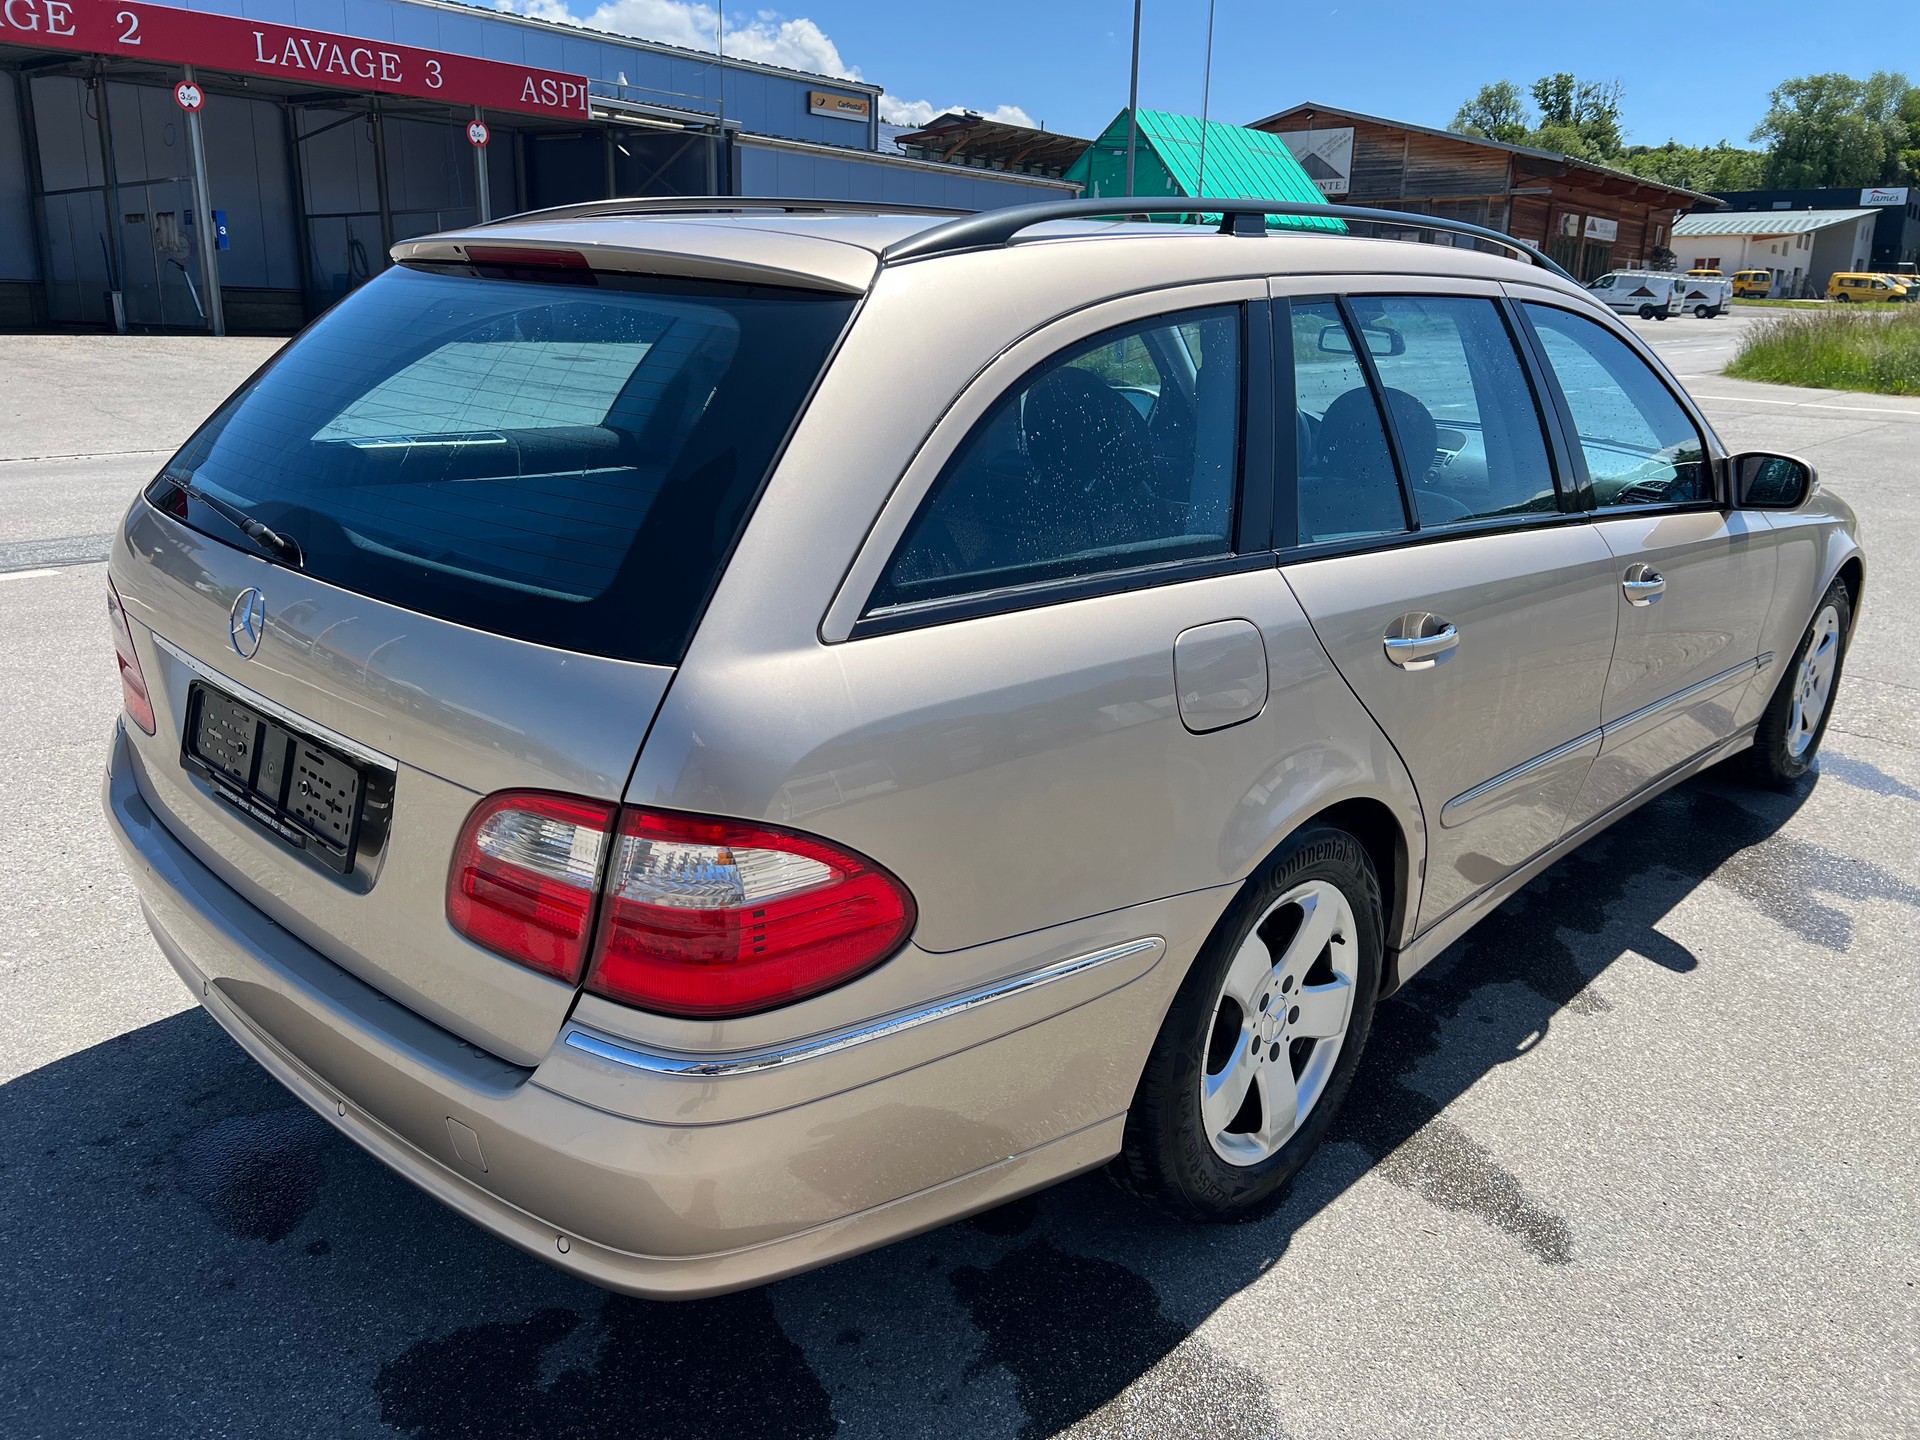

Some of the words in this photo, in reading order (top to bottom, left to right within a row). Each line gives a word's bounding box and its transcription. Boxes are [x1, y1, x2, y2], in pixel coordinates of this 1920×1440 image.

[0, 0, 76, 36] GE
[116, 11, 142, 45] 2
[253, 31, 403, 83] LAVAGE
[424, 59, 443, 88] 3
[519, 76, 587, 111] ASPI
[837, 100, 863, 111] CarPostal
[1867, 194, 1900, 204] James
[219, 226, 227, 235] 3
[1270, 838, 1349, 891] Continental
